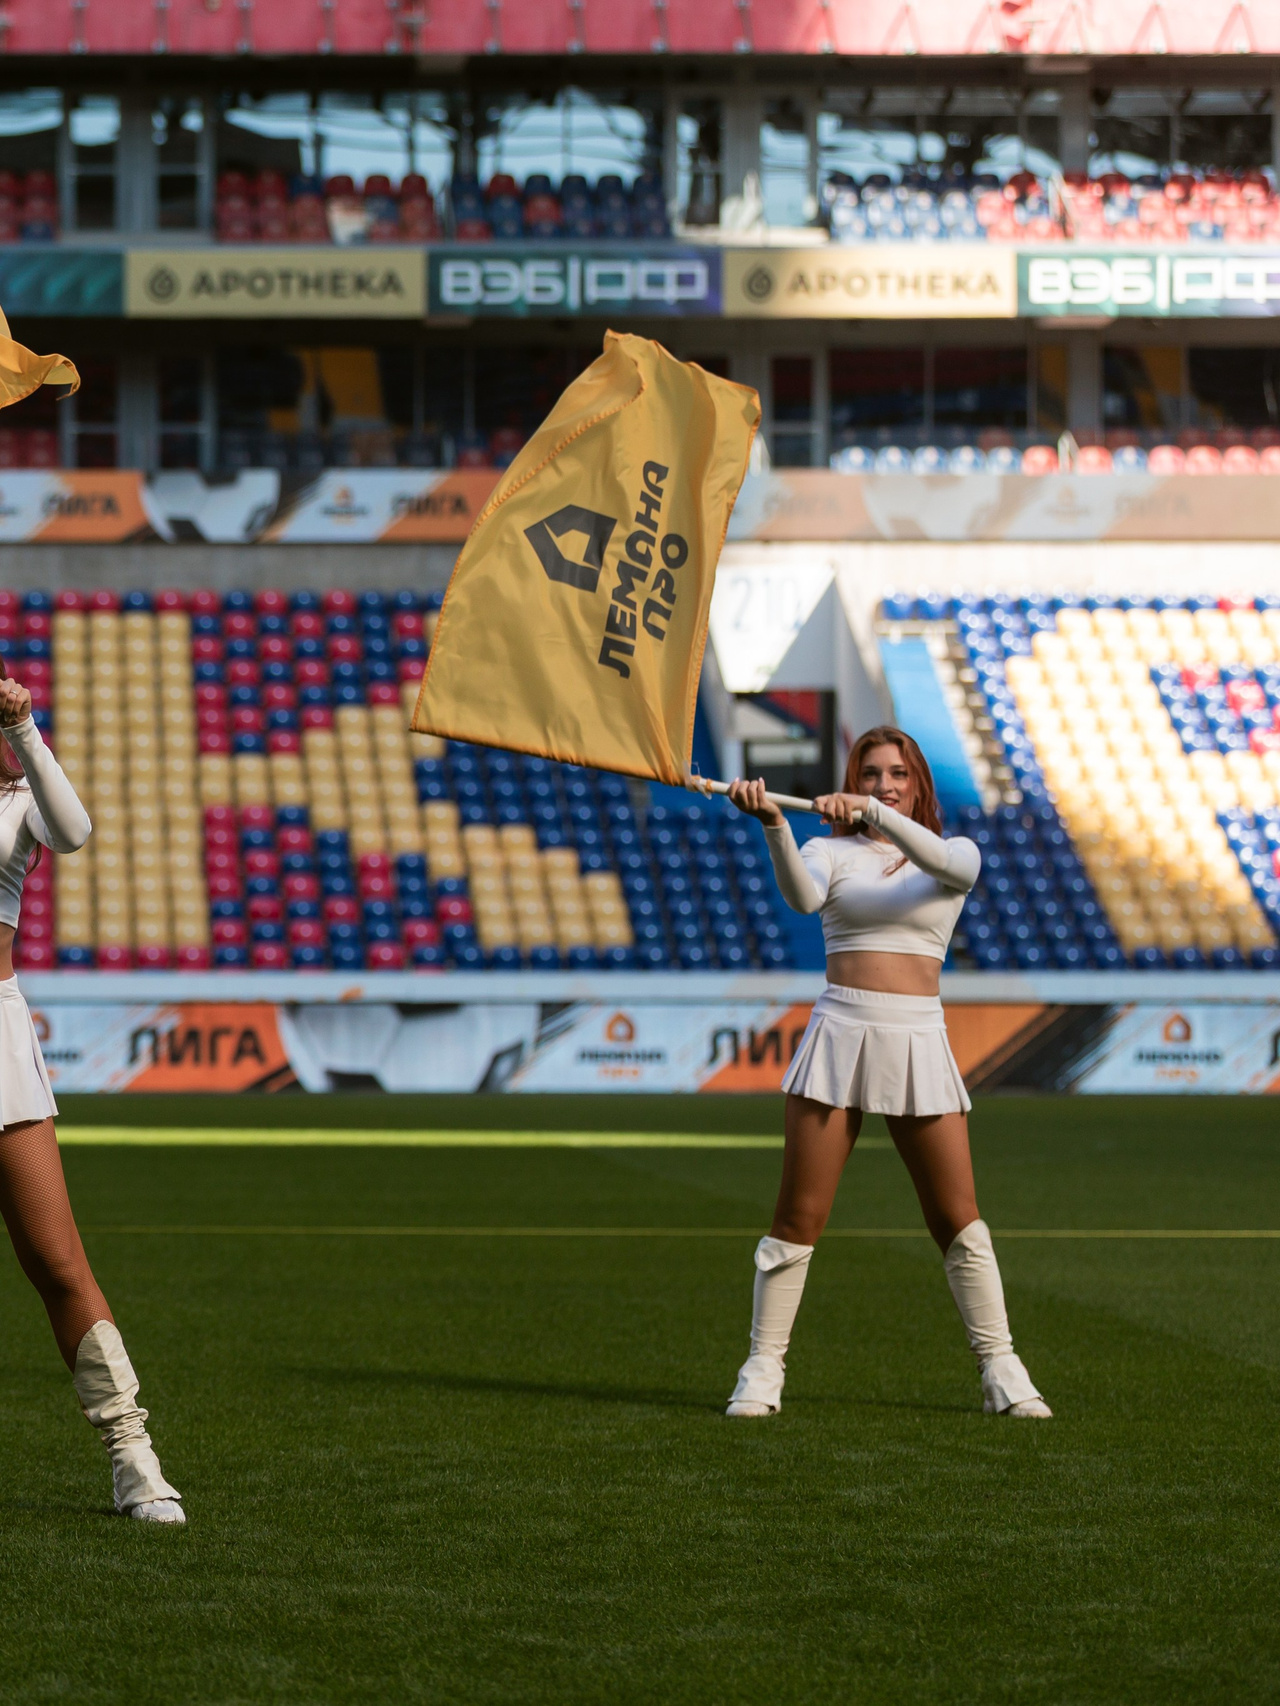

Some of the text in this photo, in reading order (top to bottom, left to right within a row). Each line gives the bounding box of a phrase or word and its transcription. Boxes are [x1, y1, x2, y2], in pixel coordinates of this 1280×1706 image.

[191, 267, 405, 299] APOTHEKA
[786, 266, 1001, 299] APOTHEKA
[598, 460, 669, 679] ЛЕМАНА
[642, 533, 688, 642] ПРО
[127, 1025, 266, 1067] ЛИГА
